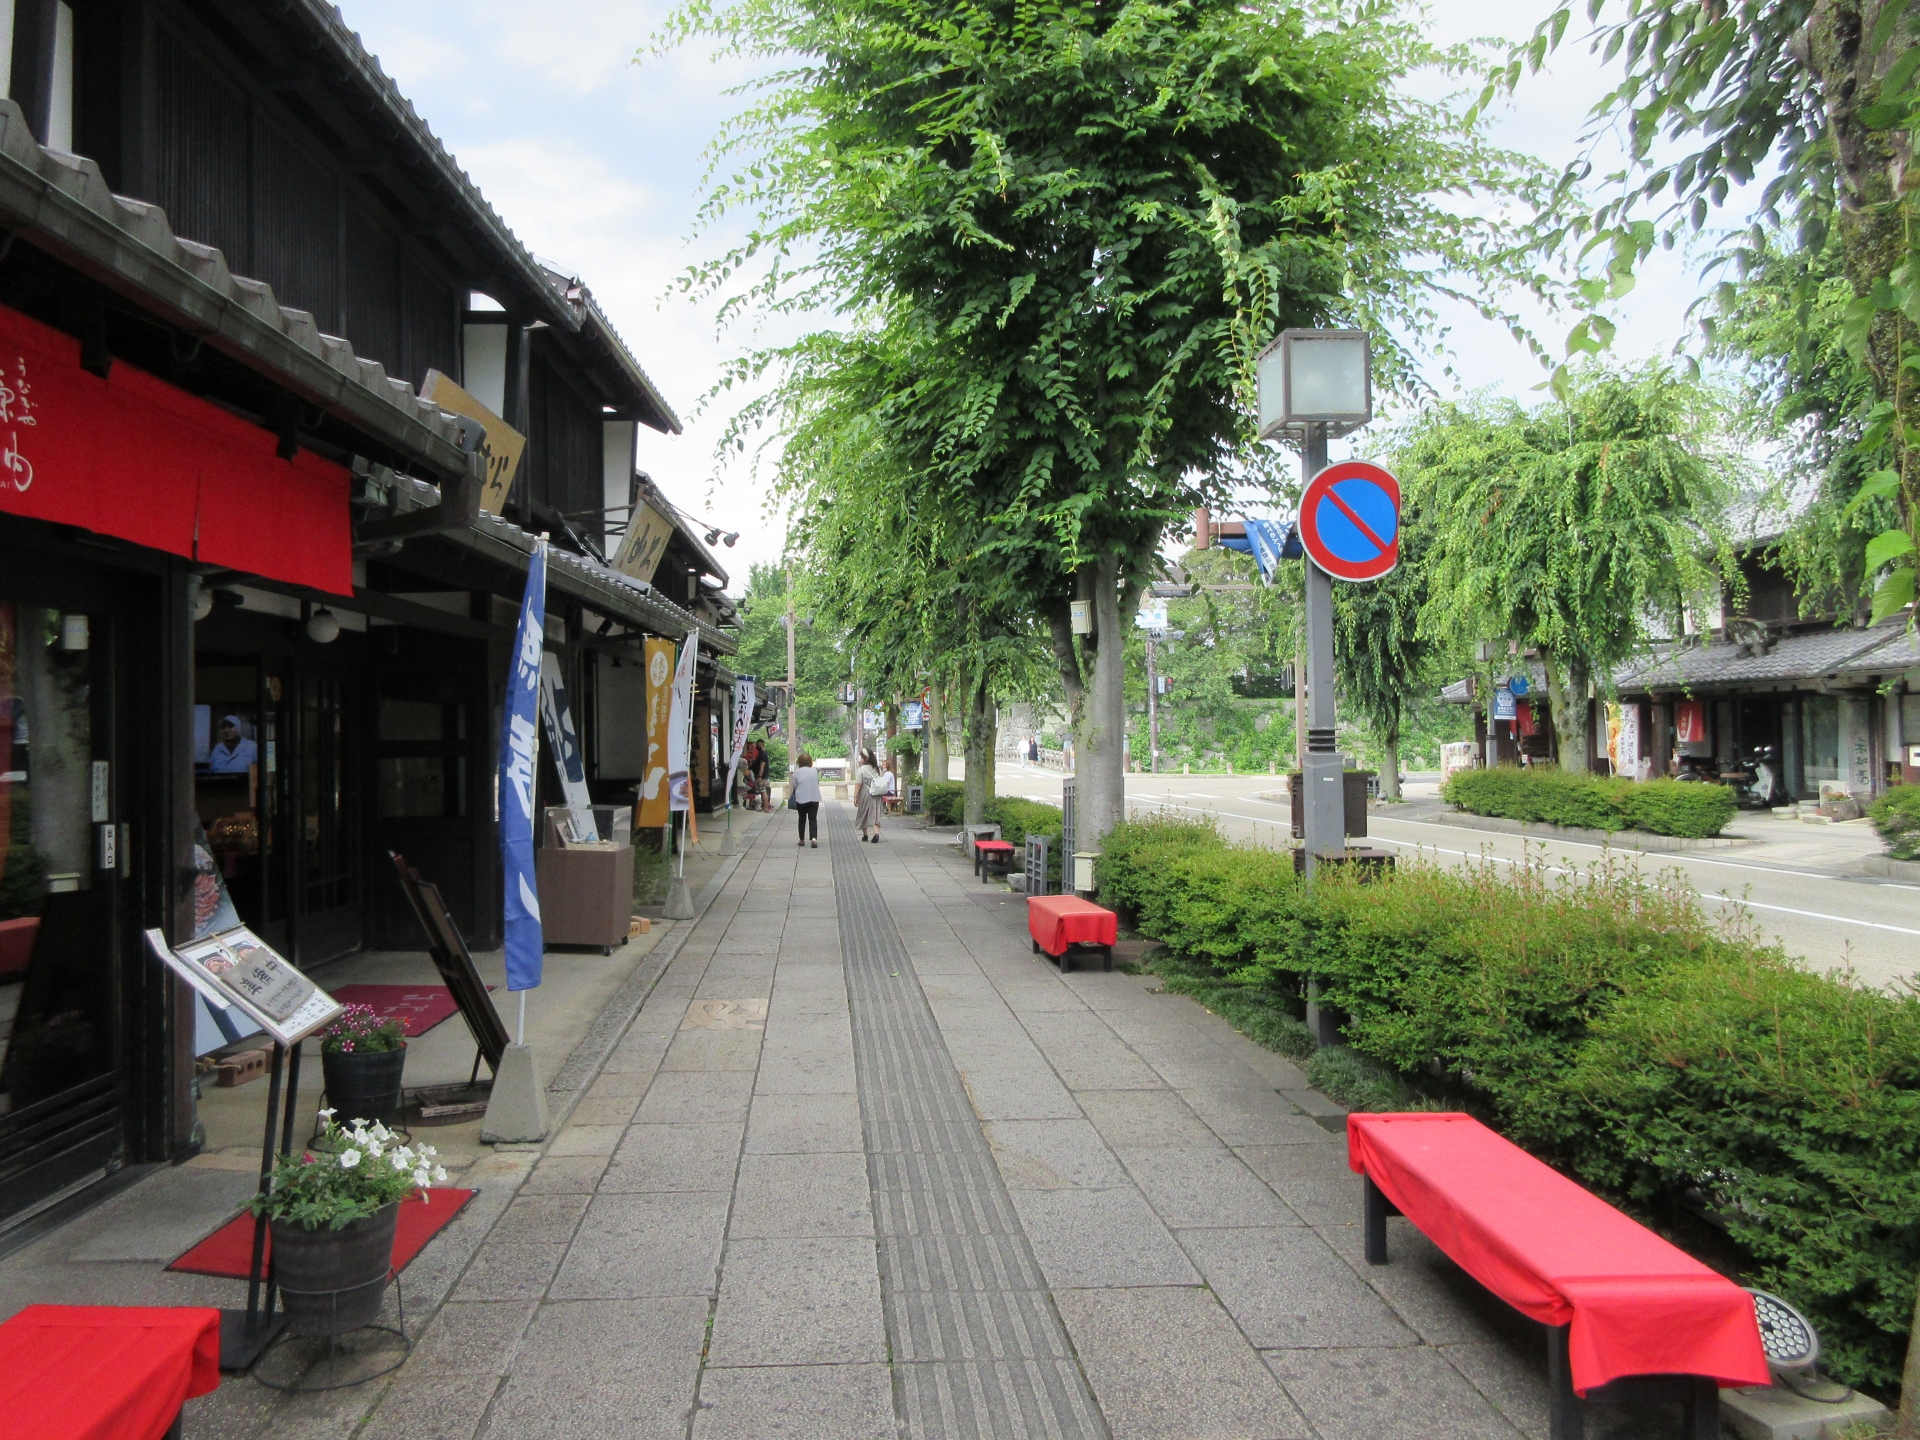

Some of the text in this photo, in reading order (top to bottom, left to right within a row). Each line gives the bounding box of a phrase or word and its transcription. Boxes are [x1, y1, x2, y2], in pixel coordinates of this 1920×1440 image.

[106, 830, 114, 865] 出入口
[239, 959, 284, 996] 準備中
